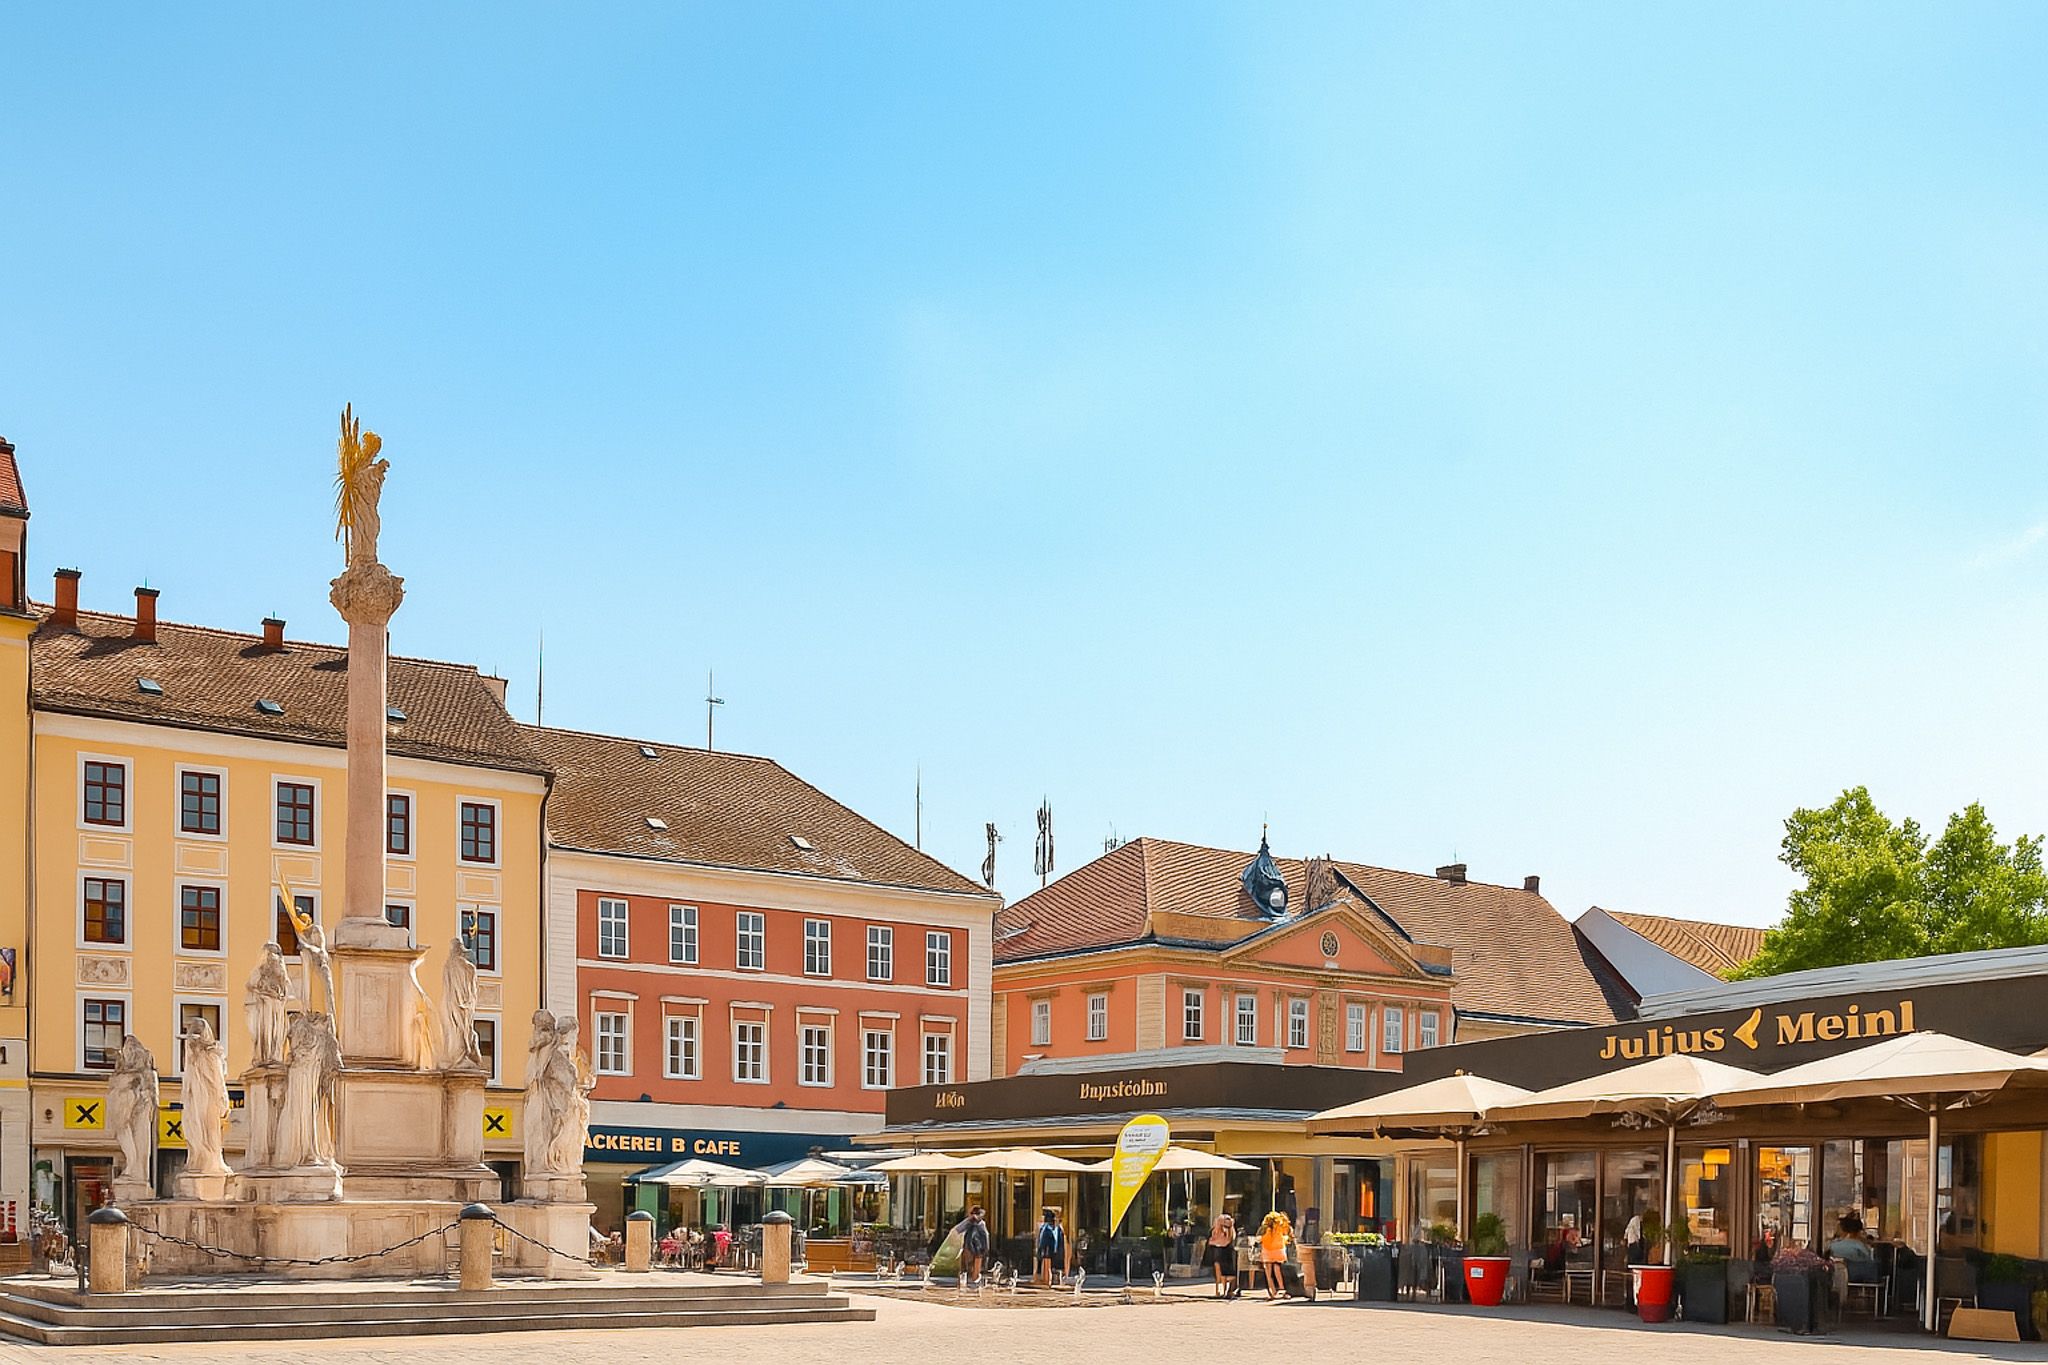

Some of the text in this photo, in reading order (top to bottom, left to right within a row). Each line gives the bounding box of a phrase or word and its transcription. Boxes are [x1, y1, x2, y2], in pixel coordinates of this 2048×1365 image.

[1599, 1000, 1916, 1060] Julius Meinl
[671, 1137, 685, 1153] B
[694, 1139, 741, 1156] CAFE
